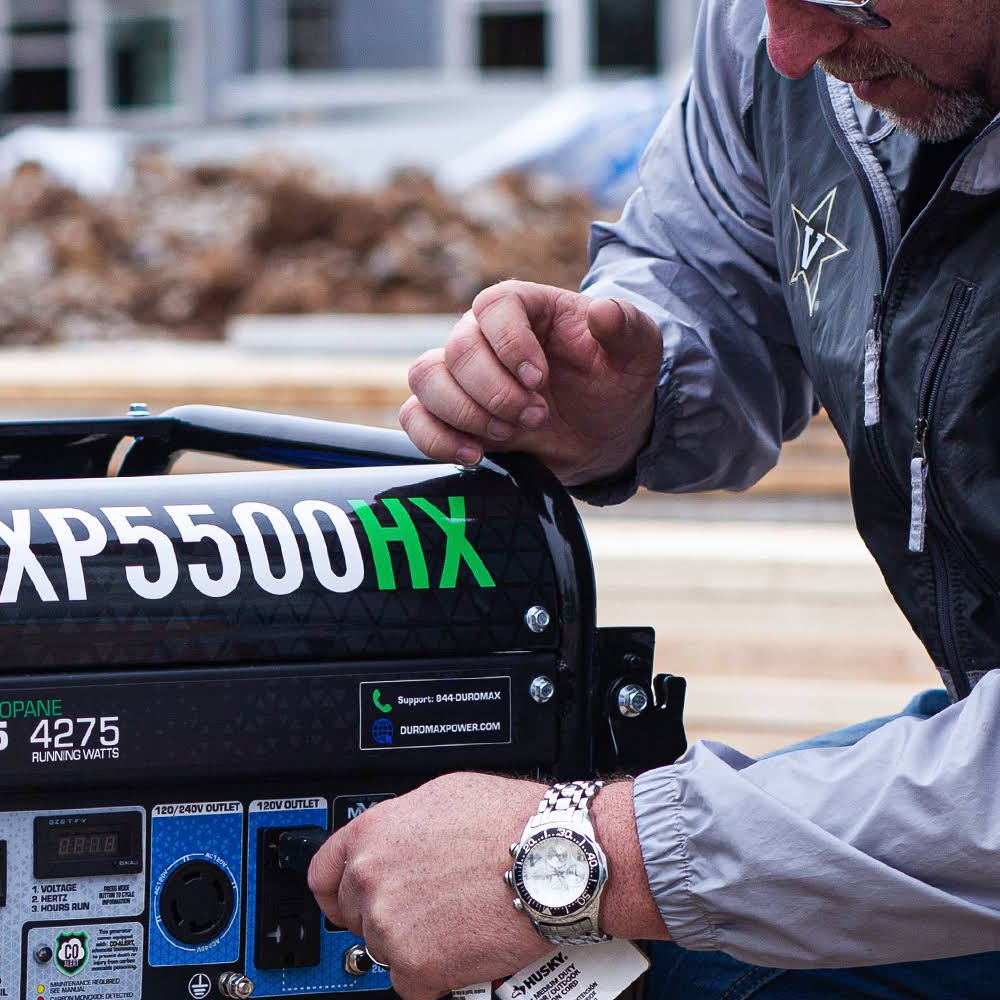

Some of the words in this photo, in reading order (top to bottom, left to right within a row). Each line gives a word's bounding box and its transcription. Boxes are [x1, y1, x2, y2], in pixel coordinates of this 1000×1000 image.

[801, 225, 826, 270] V
[398, 695, 434, 706] Support:
[436, 691, 501, 702] 844-DUROMAX
[30, 717, 120, 748] 4275
[400, 722, 501, 735] DUROMAXPOWER.COM
[32, 750, 81, 762] RUNNING
[82, 748, 120, 759] WATTS
[155, 804, 204, 816] 120/240V
[205, 802, 240, 811] OUTLET
[257, 801, 283, 810] 120V
[284, 799, 319, 809] OUTLET
[558, 828, 573, 838] 30
[523, 840, 536, 853] 20
[587, 853, 598, 867] 40
[41, 884, 77, 893] VOLTAGE
[41, 894, 67, 902] HERTZ
[577, 891, 591, 905] 50
[41, 903, 70, 912] HOURS
[72, 902, 90, 910] RUN
[65, 944, 78, 959] CO
[50, 980, 92, 988] MAINTENANCE
[533, 977, 559, 999] MEDIUM
[558, 963, 576, 981] DUTY
[550, 970, 581, 995] OUTDOOR
[561, 980, 579, 995] CORD
